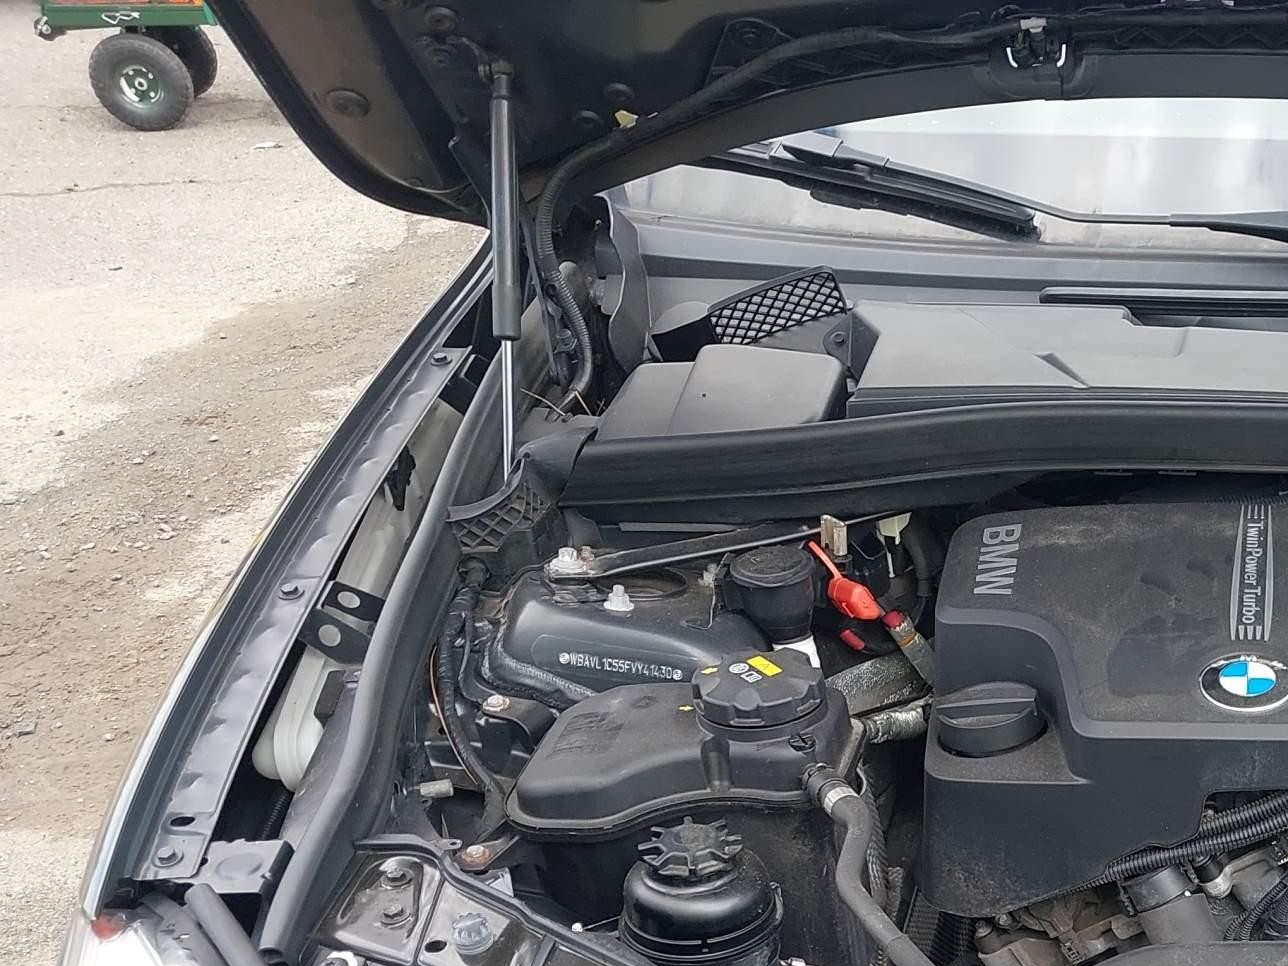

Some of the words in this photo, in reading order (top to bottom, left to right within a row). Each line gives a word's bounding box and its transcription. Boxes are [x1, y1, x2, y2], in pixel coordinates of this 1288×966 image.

[974, 524, 1022, 595] BMW
[1244, 521, 1264, 585] TwinPower
[1242, 586, 1261, 624] Turbo
[569, 652, 673, 679] WBAVL1C55FVY41430
